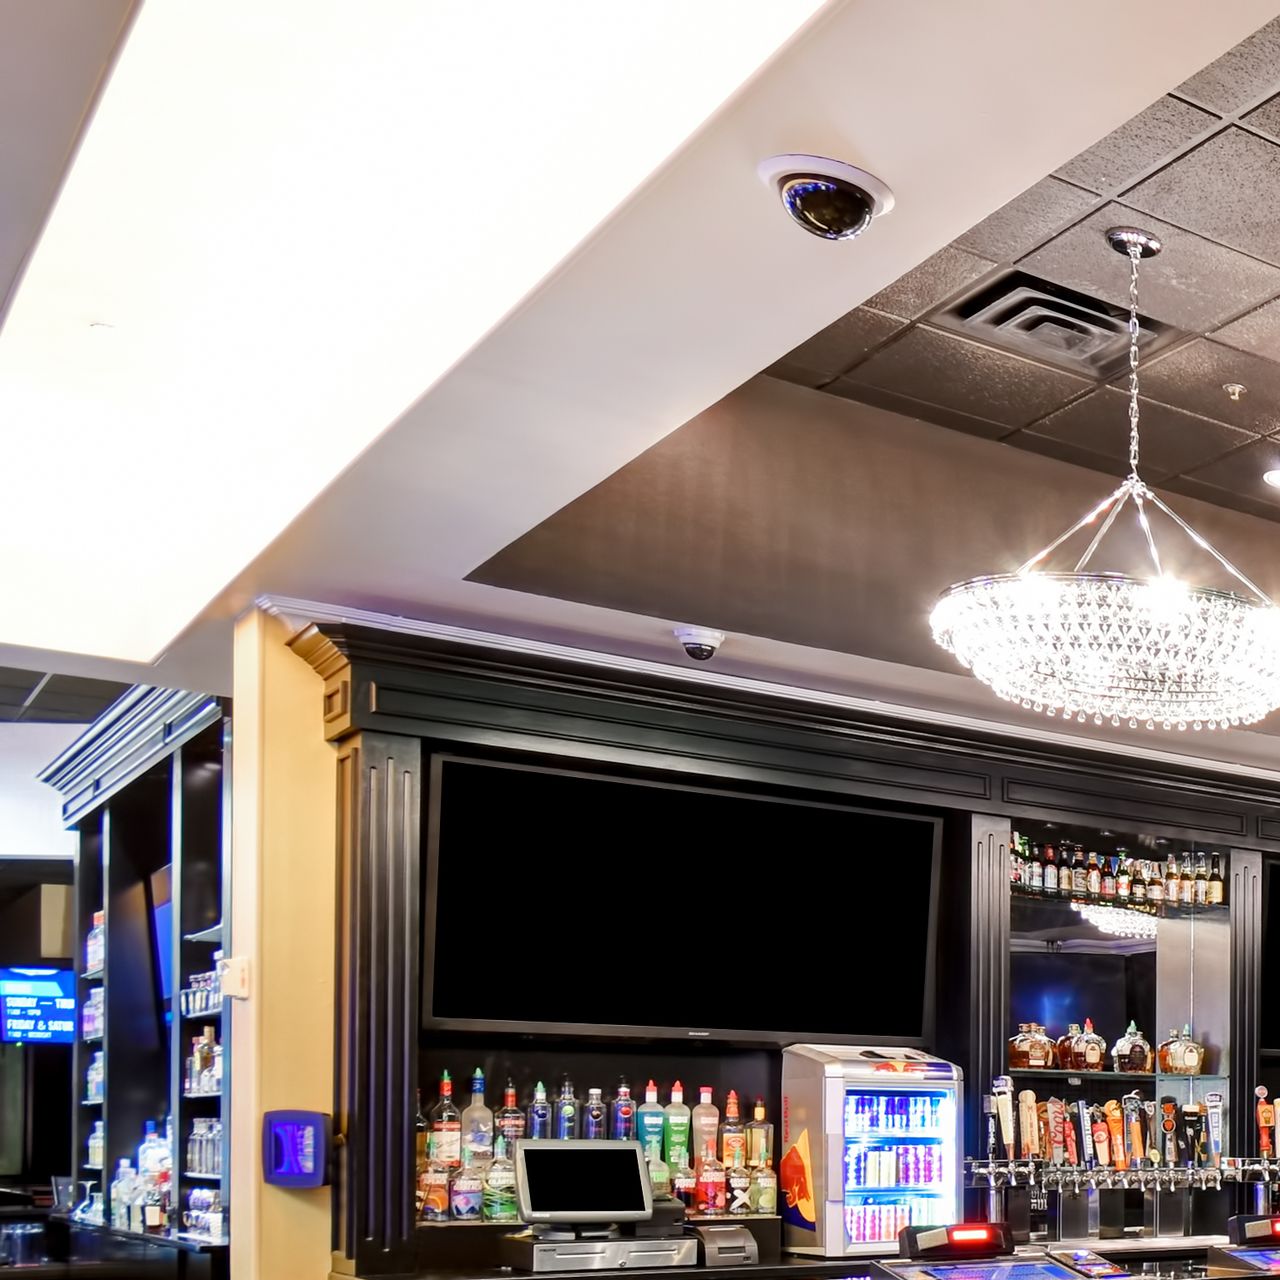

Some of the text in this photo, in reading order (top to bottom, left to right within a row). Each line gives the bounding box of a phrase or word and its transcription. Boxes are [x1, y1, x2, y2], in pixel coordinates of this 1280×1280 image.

[1049, 1103, 1065, 1146] Coors
[1083, 1108, 1094, 1154] BUD LIGHT
